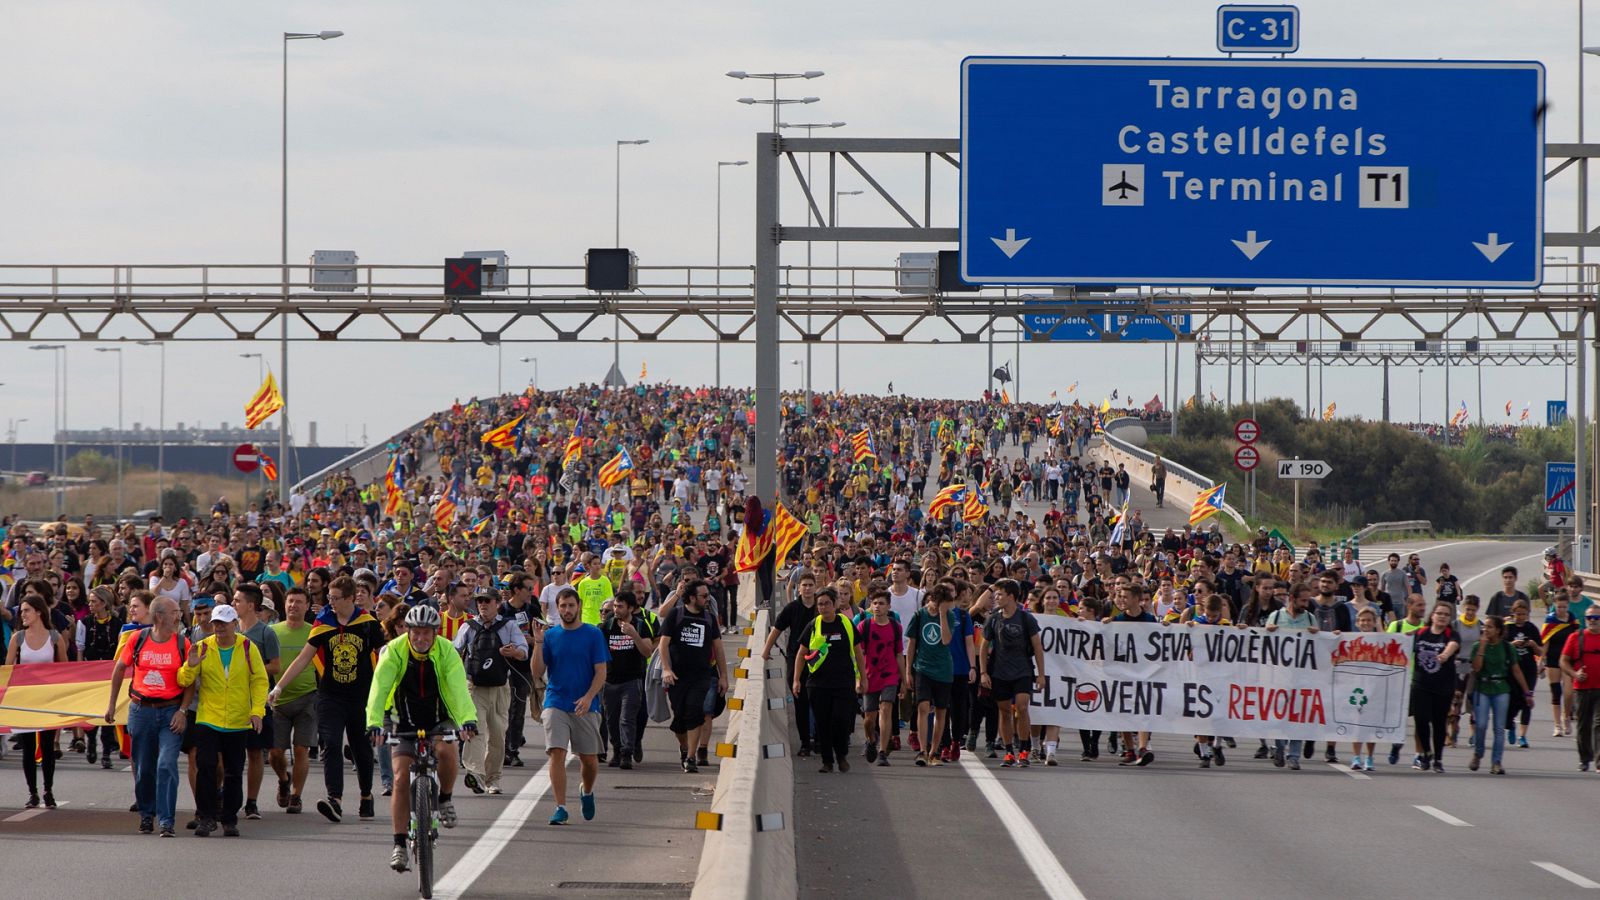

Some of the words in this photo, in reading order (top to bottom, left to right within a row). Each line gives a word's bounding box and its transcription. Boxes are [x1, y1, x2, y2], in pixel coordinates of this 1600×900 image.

[1227, 18, 1290, 41] C-31
[1149, 79, 1358, 119] Tarragona
[1118, 125, 1387, 156] Castelldefels
[1162, 171, 1342, 202] Terminal
[1367, 173, 1401, 202] T1
[1300, 463, 1324, 476] 190
[1040, 626, 1105, 661] ONTRA
[1113, 632, 1138, 664] LA
[1143, 631, 1194, 662] SEVA
[1182, 682, 1214, 719] ES
[1228, 683, 1327, 726] REVOLTA
